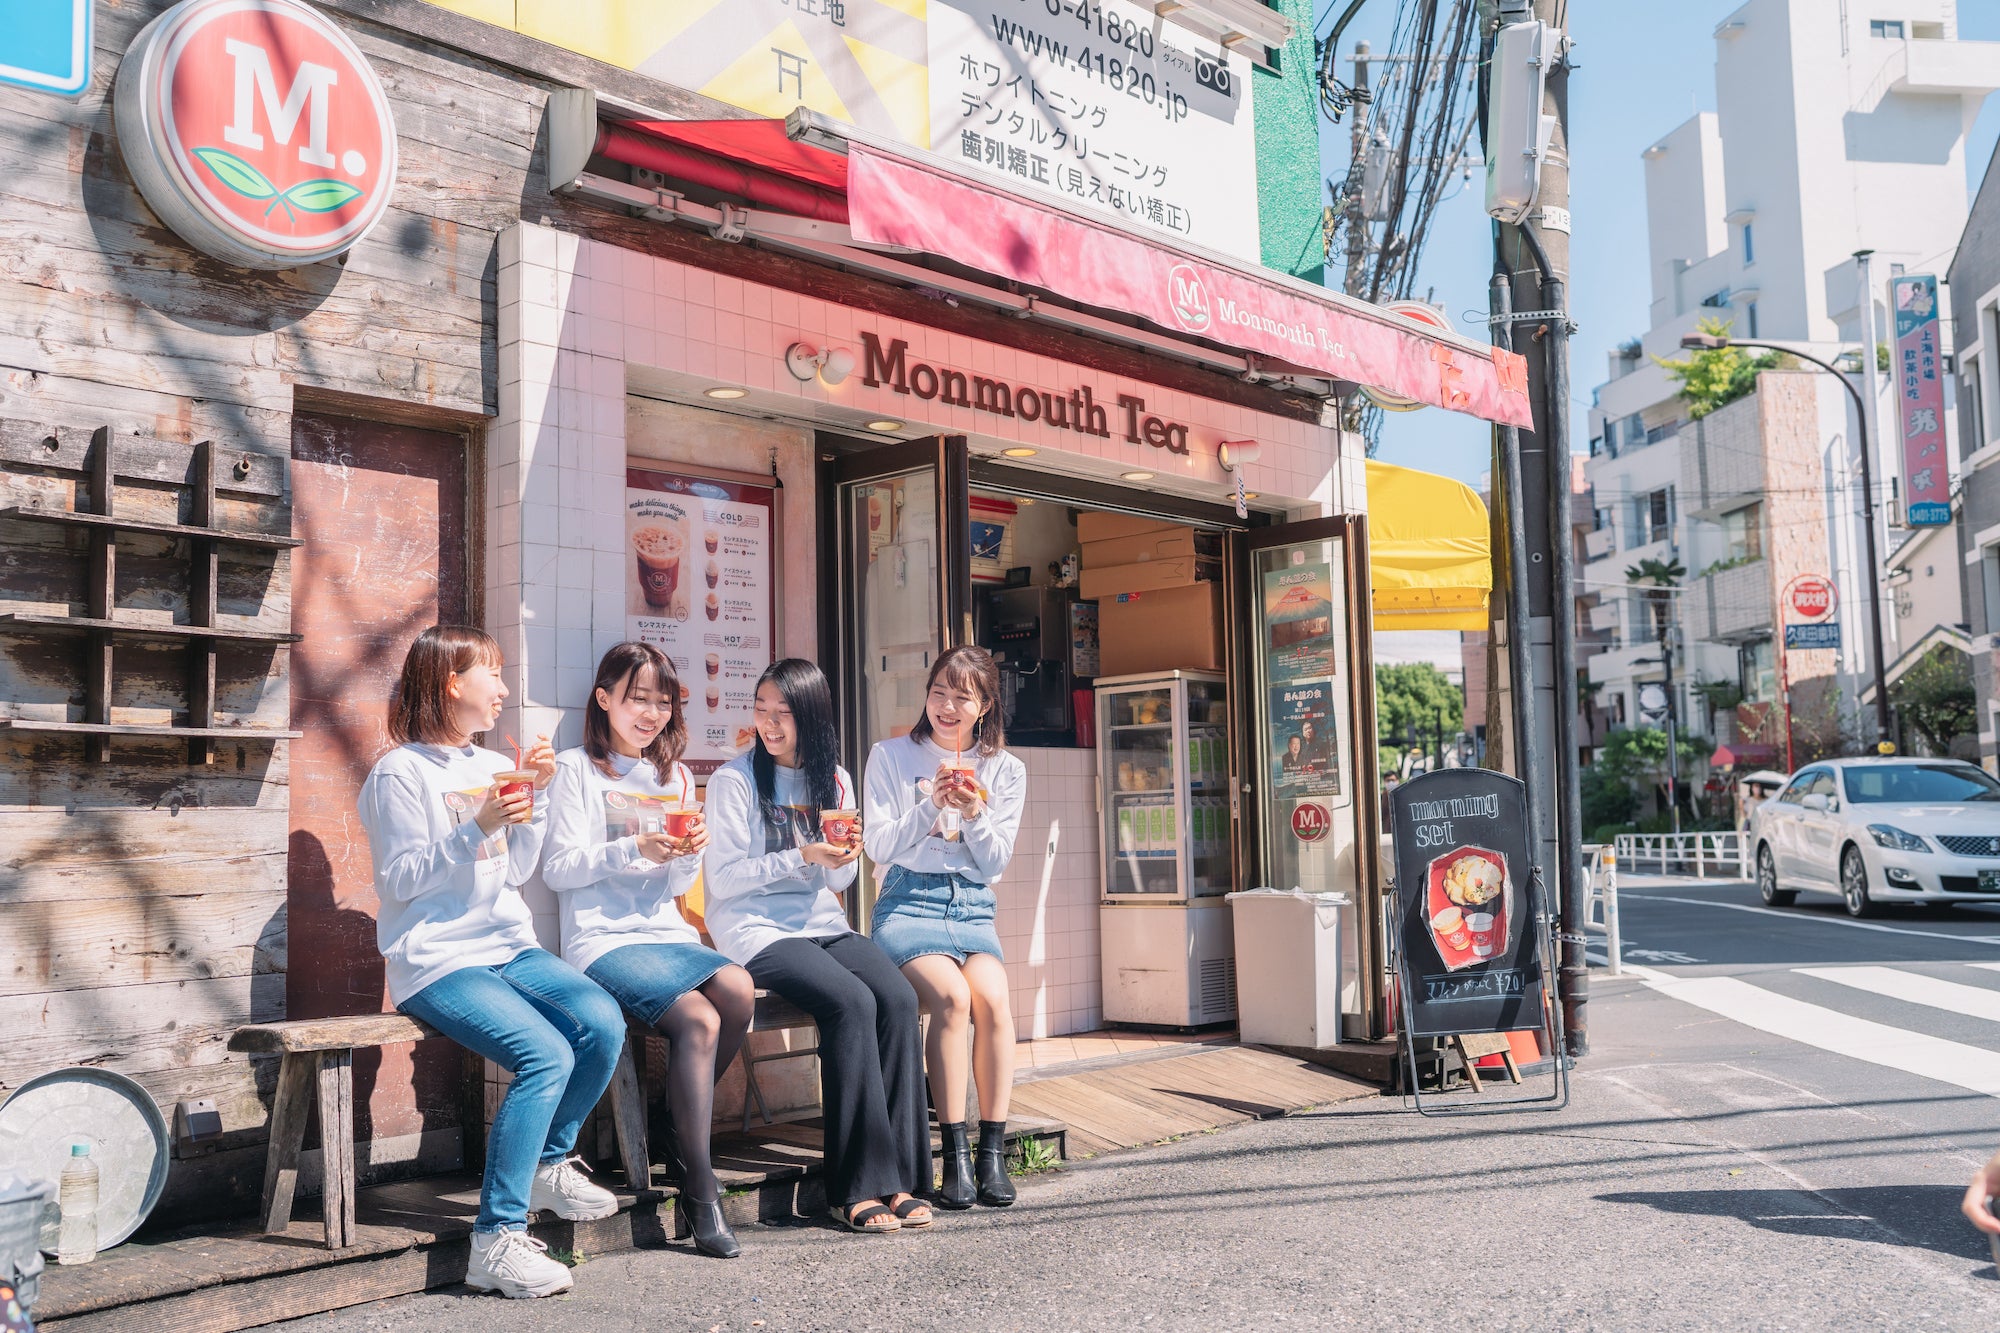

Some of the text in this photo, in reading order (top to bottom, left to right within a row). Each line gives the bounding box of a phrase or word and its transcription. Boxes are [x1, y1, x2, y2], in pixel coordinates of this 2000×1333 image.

[1162, 39, 1184, 54] フリー
[992, 14, 1187, 122] www.41820.jp
[1162, 53, 1192, 73] ダイアル
[960, 54, 1108, 129] ホワイトニング
[961, 92, 1168, 188] デンタルクリーニング
[1217, 297, 1345, 359] Monmouth Tea
[1898, 320, 1912, 331] 1F
[1921, 330, 1936, 380] 上海市場
[861, 332, 1190, 456] Monmouth Tea
[629, 500, 644, 509] make
[645, 499, 668, 509] delicious
[637, 509, 652, 517] make
[653, 510, 664, 518] you
[720, 512, 742, 521] COLD
[1911, 507, 1949, 522] 3401-3775
[1794, 591, 1828, 607] 消火栓
[638, 621, 679, 629] モンマスティー
[724, 635, 741, 643] HOT
[706, 728, 726, 736] CAKE
[1409, 793, 1499, 820] morning
[1416, 821, 1457, 848] set
